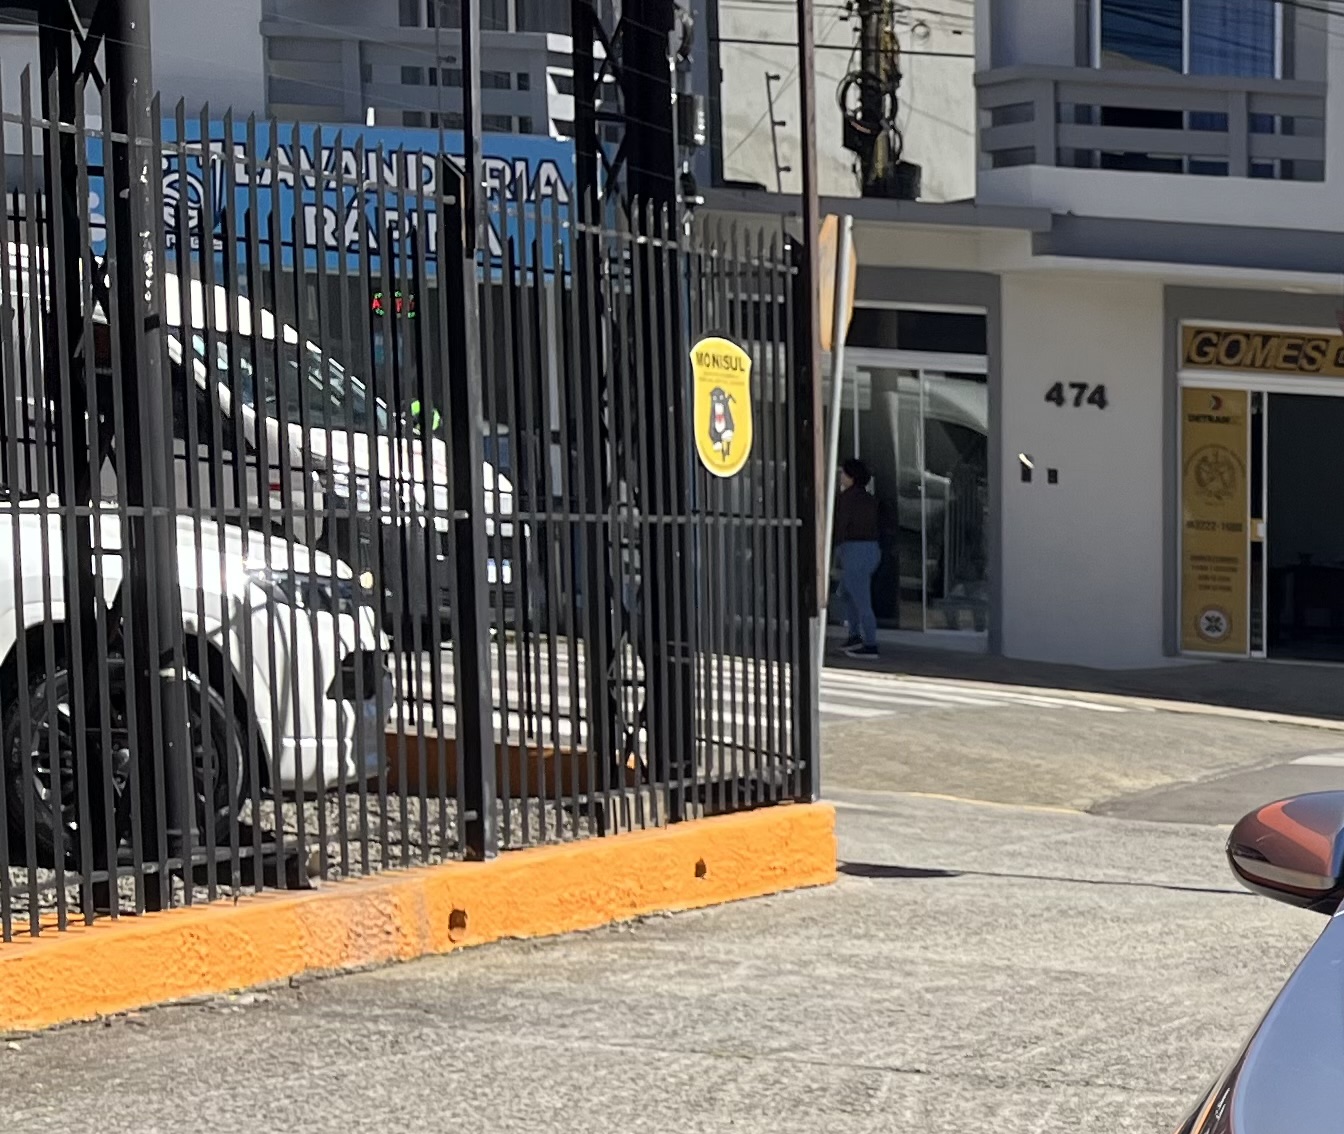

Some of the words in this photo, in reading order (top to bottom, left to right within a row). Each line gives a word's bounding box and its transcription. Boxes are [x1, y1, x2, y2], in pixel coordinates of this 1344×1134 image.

[234, 144, 570, 203] LAVANDRIA
[695, 351, 746, 372] MONISUL
[1187, 331, 1331, 371] GOMES
[1044, 381, 1109, 410] 474
